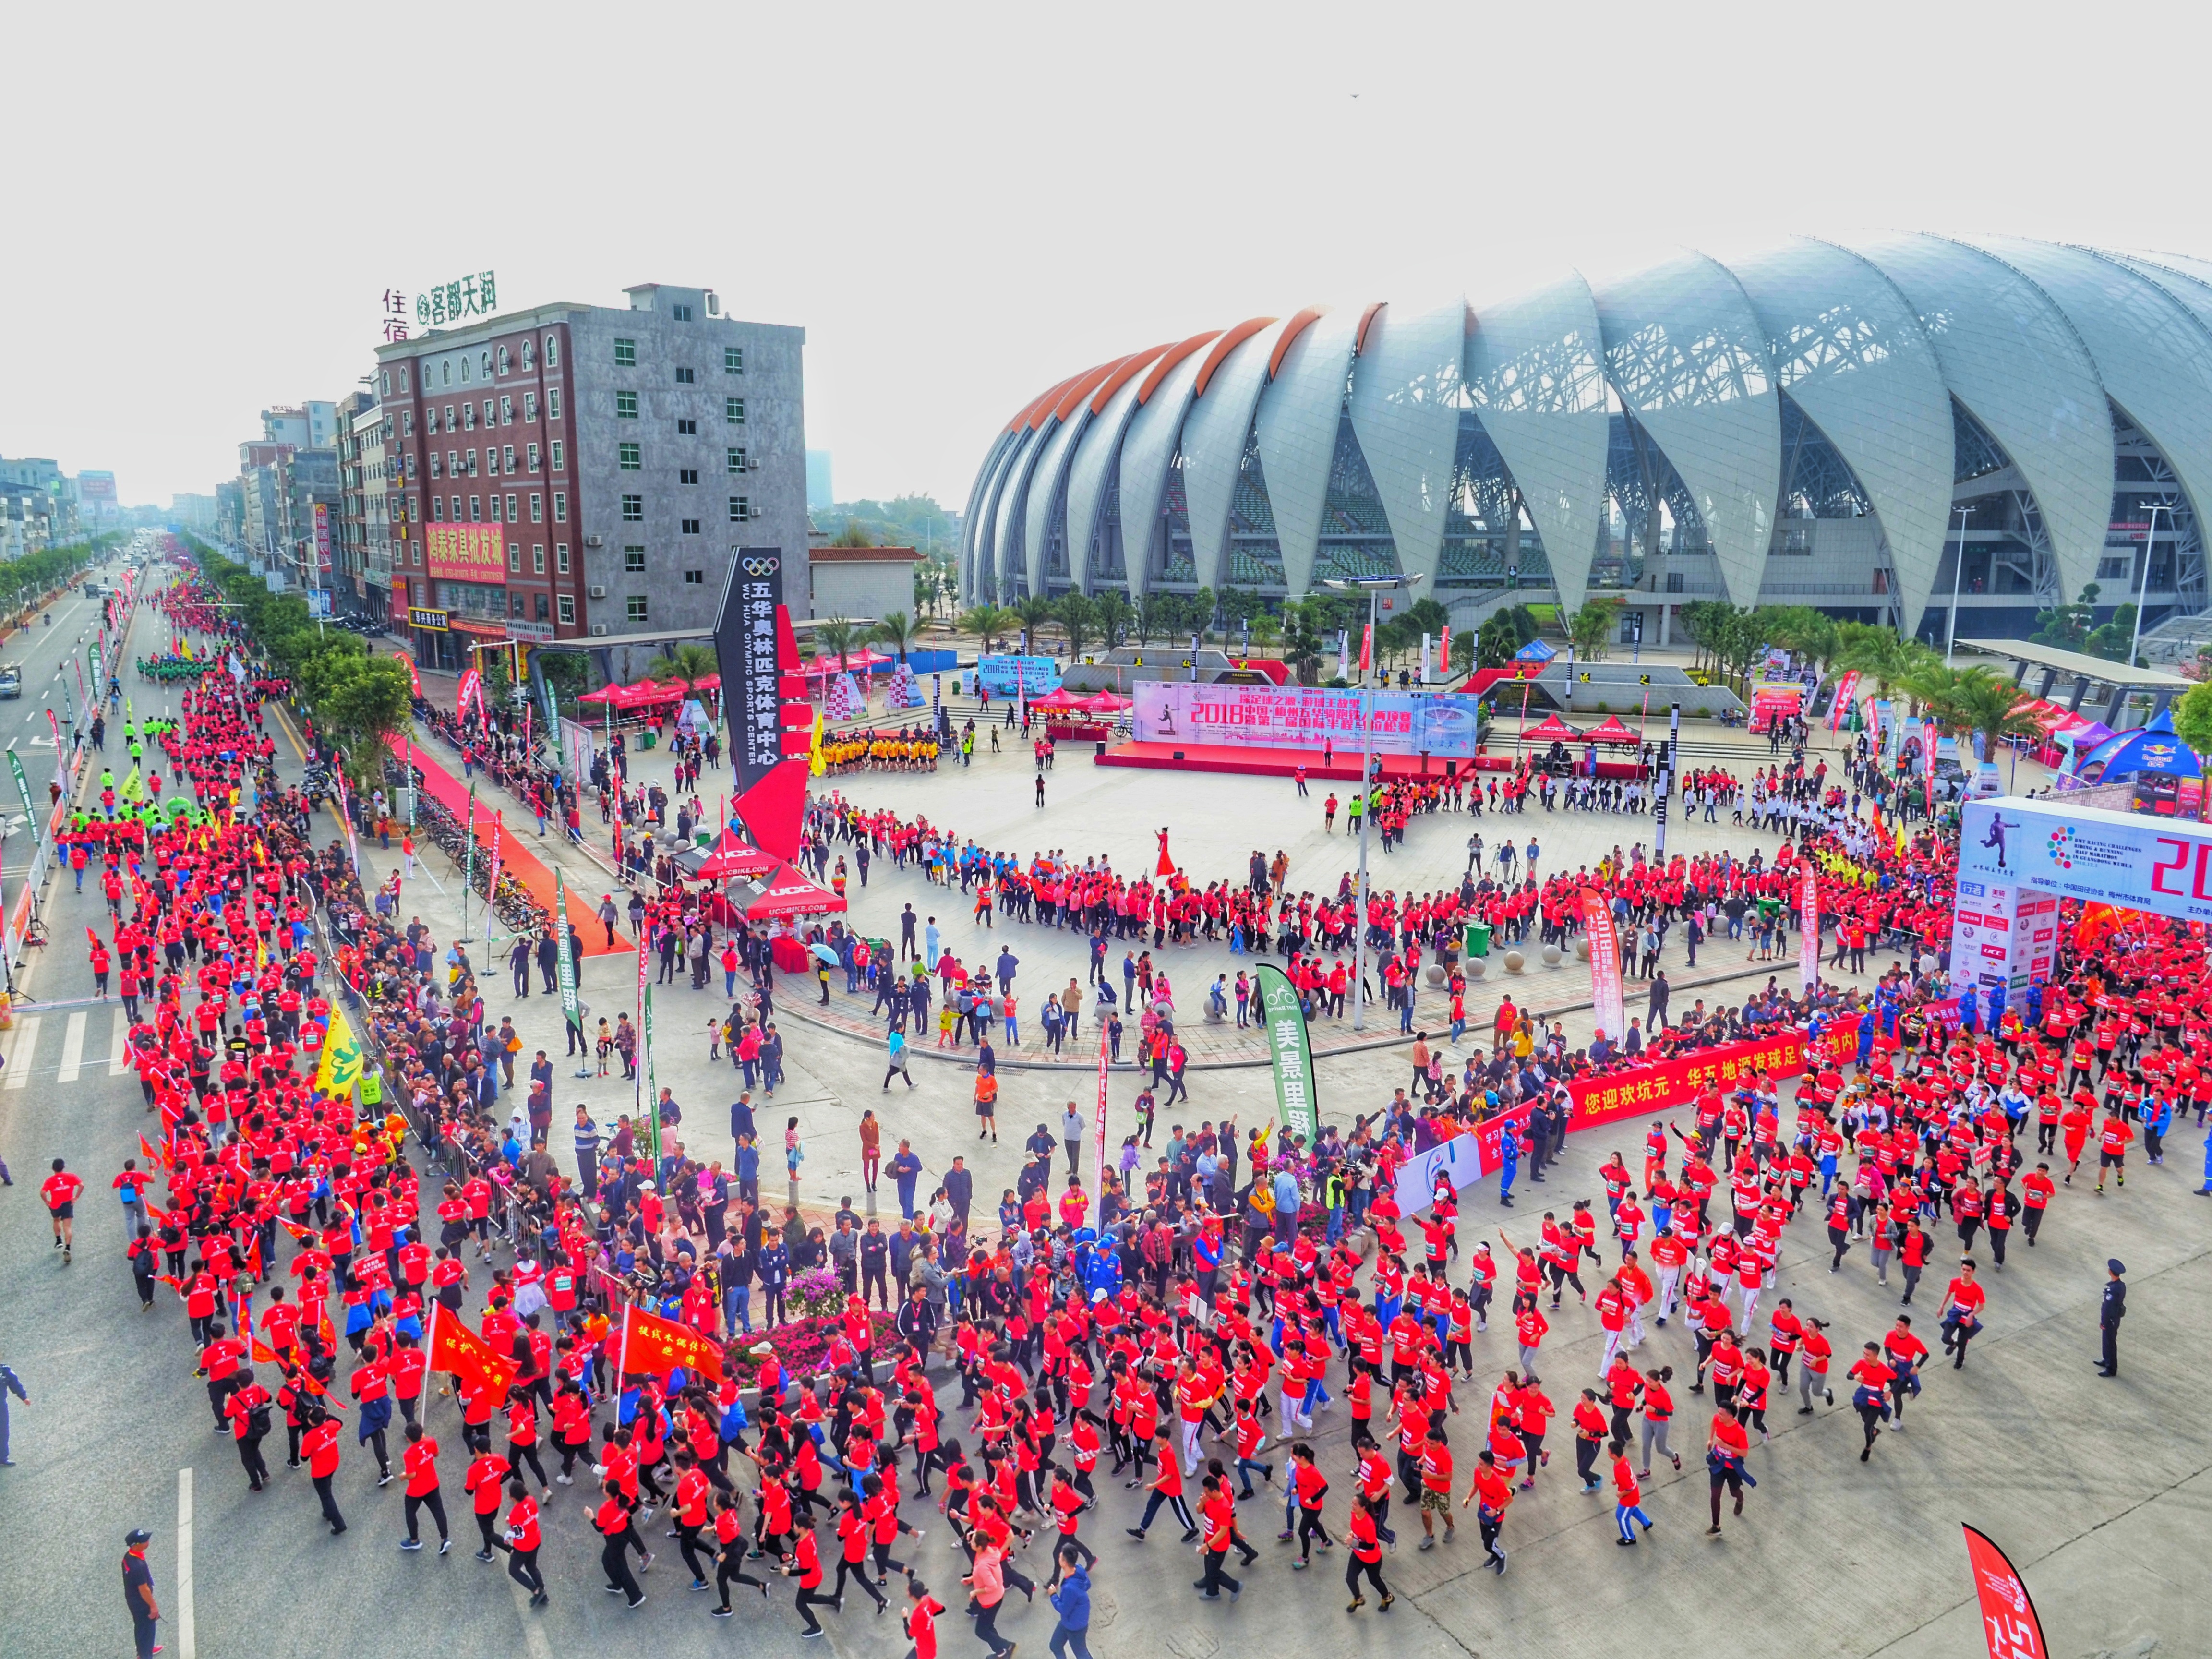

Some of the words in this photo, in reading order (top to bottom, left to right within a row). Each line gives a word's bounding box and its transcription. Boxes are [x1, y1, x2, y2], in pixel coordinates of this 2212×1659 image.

[383, 289, 407, 341] 住宿
[428, 528, 503, 566] 鸿泰家具批发城
[742, 584, 750, 600] WU
[751, 582, 778, 765] 五华奥林匹克体育中心
[746, 681, 754, 721] SPORTS
[1239, 694, 1361, 708] 探足球之源·游球王故里
[1190, 703, 1244, 725] 2018
[747, 726, 756, 765] CENTER
[716, 849, 757, 859] UCC
[2108, 843, 2141, 853] CHALLENGES
[718, 866, 768, 876] UCCBIKE.COM
[770, 886, 815, 896] UCC
[1963, 883, 1982, 895] 行者
[2063, 882, 2104, 897] 中国田径协会
[2108, 890, 2151, 905] 梅州市体育局
[769, 904, 827, 915] UCCBIKE.COM
